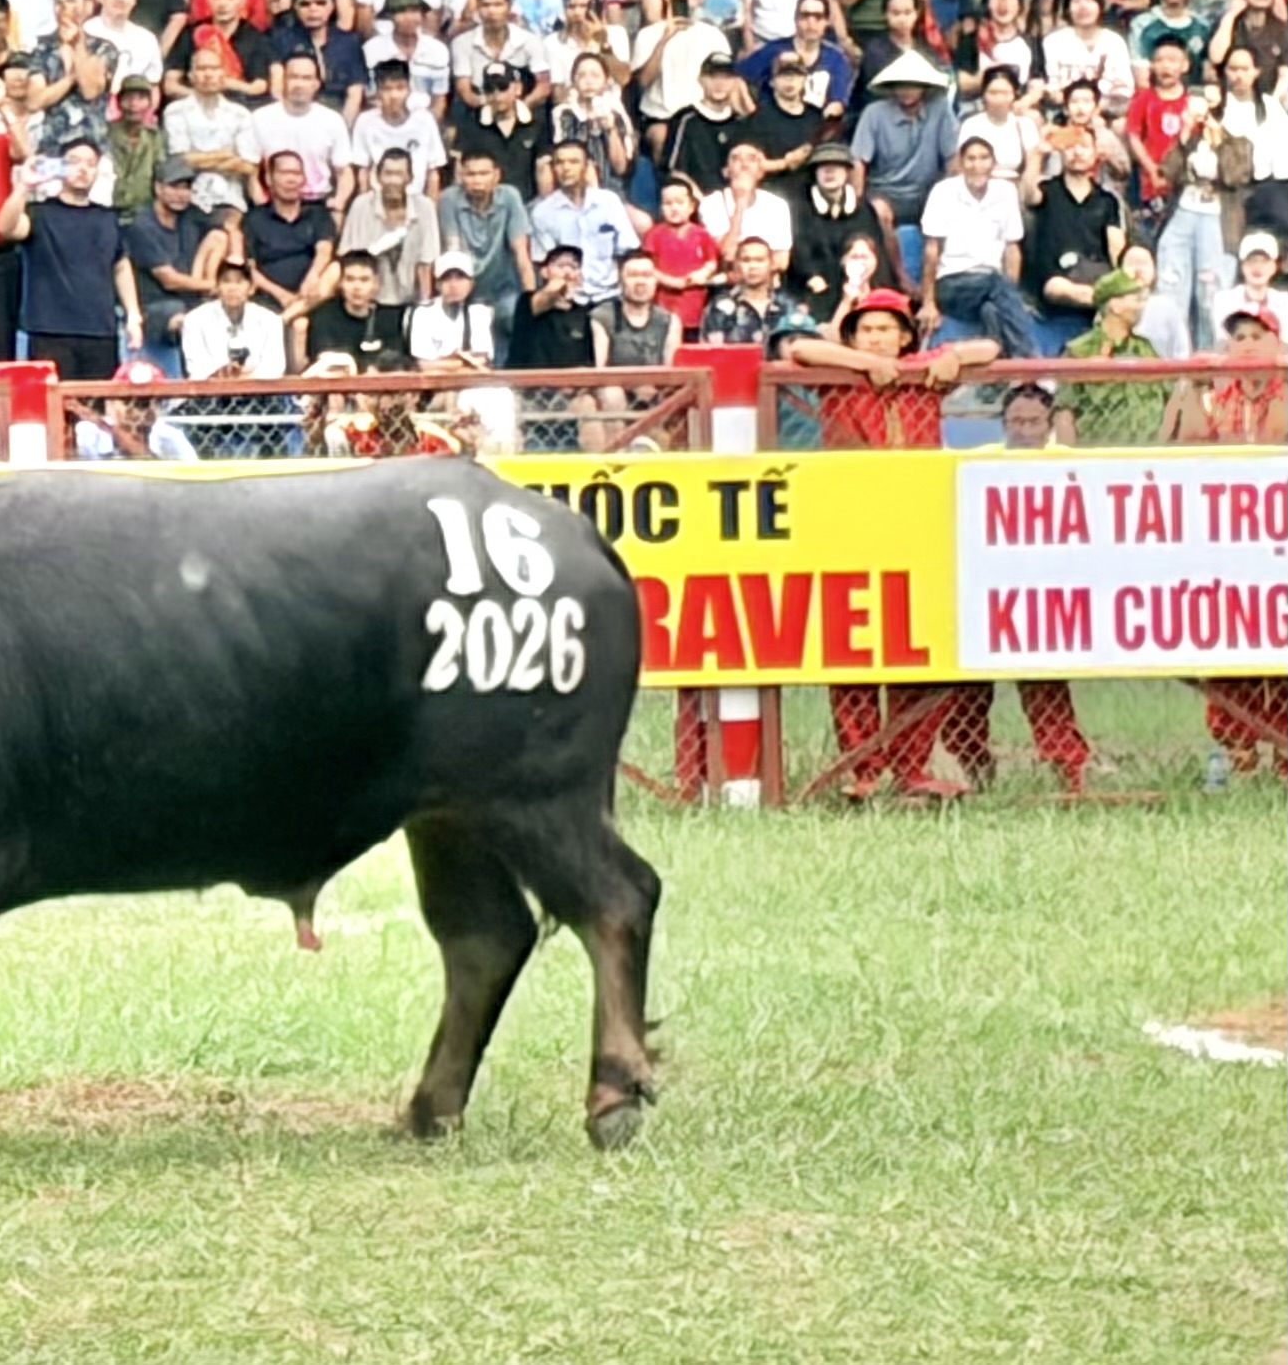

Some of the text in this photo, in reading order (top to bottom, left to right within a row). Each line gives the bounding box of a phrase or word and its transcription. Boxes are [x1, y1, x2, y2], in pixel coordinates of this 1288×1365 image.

[708, 464, 797, 540] TẾ
[985, 471, 1090, 546] NHÀ
[1106, 470, 1183, 544] TÀI
[427, 498, 555, 596] 16
[422, 597, 585, 694] 2026
[636, 570, 930, 672] RAVEL
[988, 587, 1093, 653] KIM
